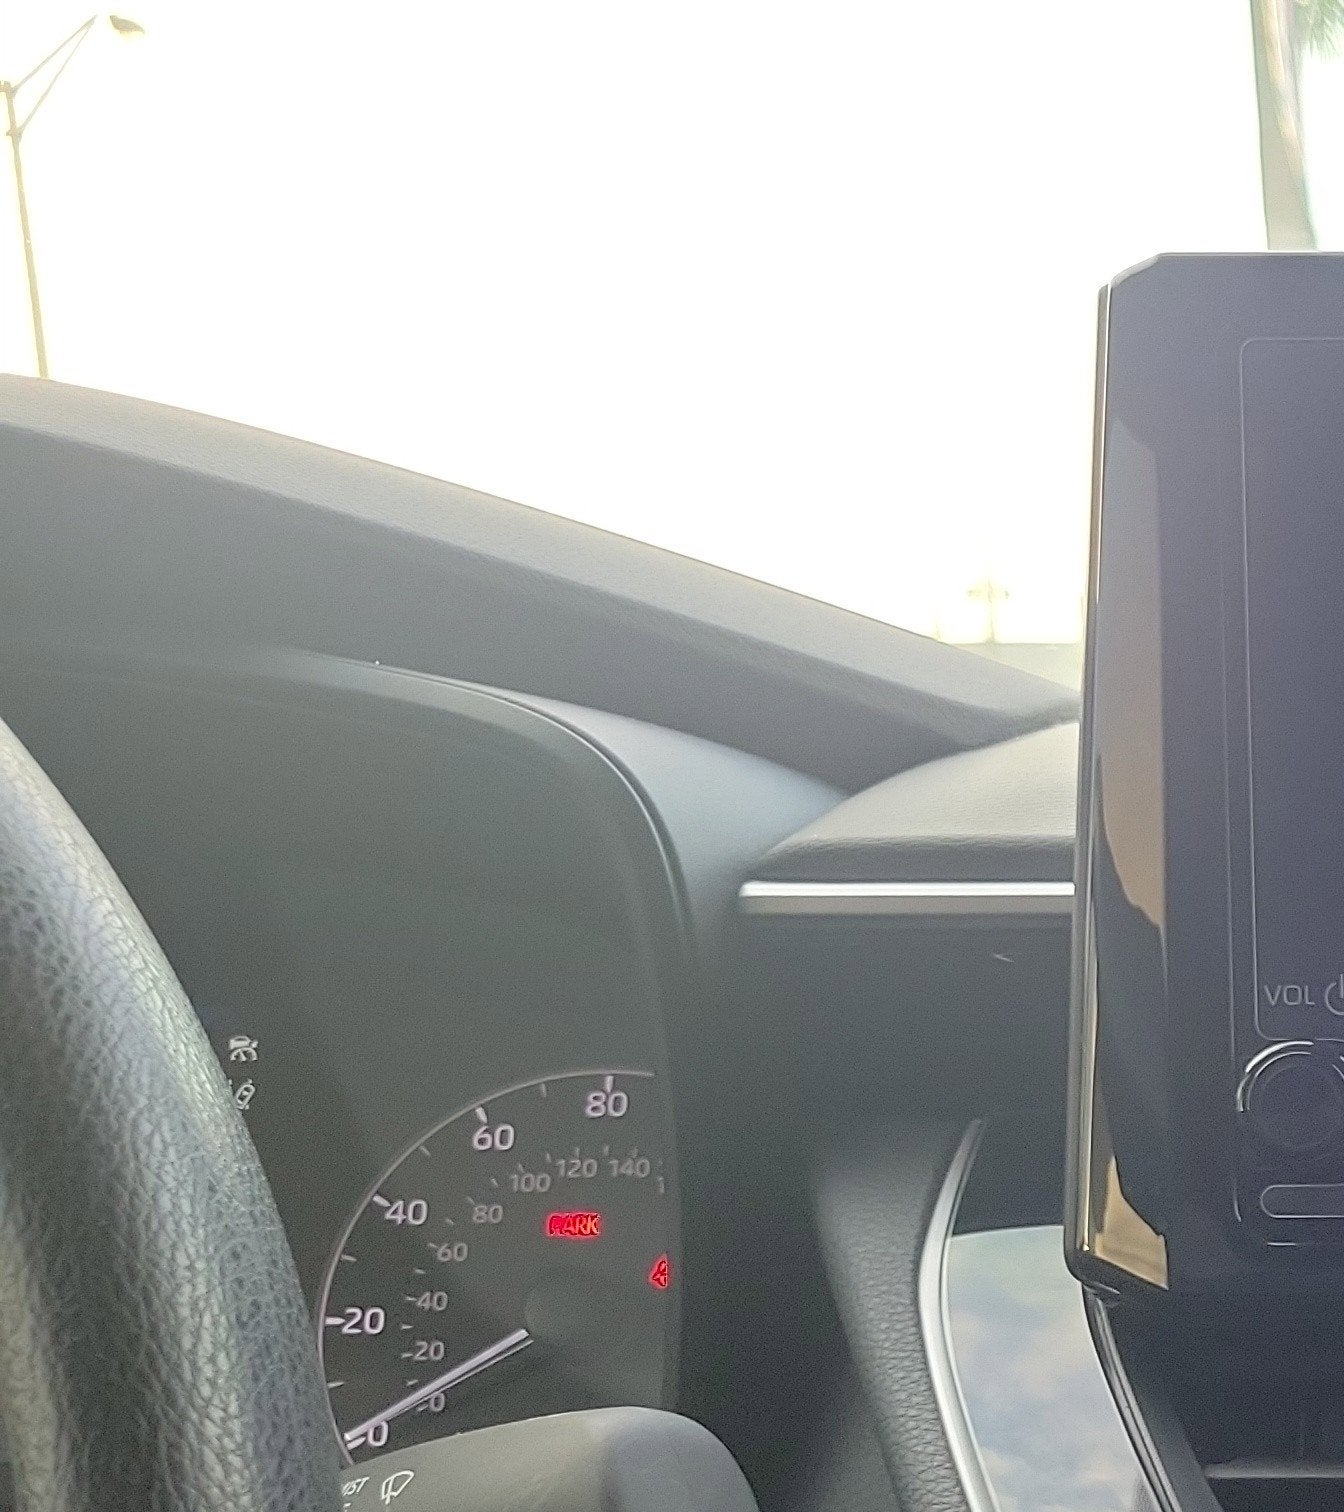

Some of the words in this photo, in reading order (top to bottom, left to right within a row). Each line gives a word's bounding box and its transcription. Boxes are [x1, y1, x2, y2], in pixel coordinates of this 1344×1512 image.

[1263, 984, 1316, 1007] VOL
[585, 1091, 628, 1119] 80
[472, 1124, 515, 1151] 60
[555, 1158, 597, 1178] 120
[609, 1158, 650, 1178] 140
[509, 1172, 550, 1193] 100
[384, 1200, 428, 1226] 40
[472, 1204, 502, 1224] 80
[437, 1242, 467, 1262] 60
[418, 1291, 448, 1311] 40
[342, 1307, 384, 1334] 20
[413, 1341, 444, 1361] 20
